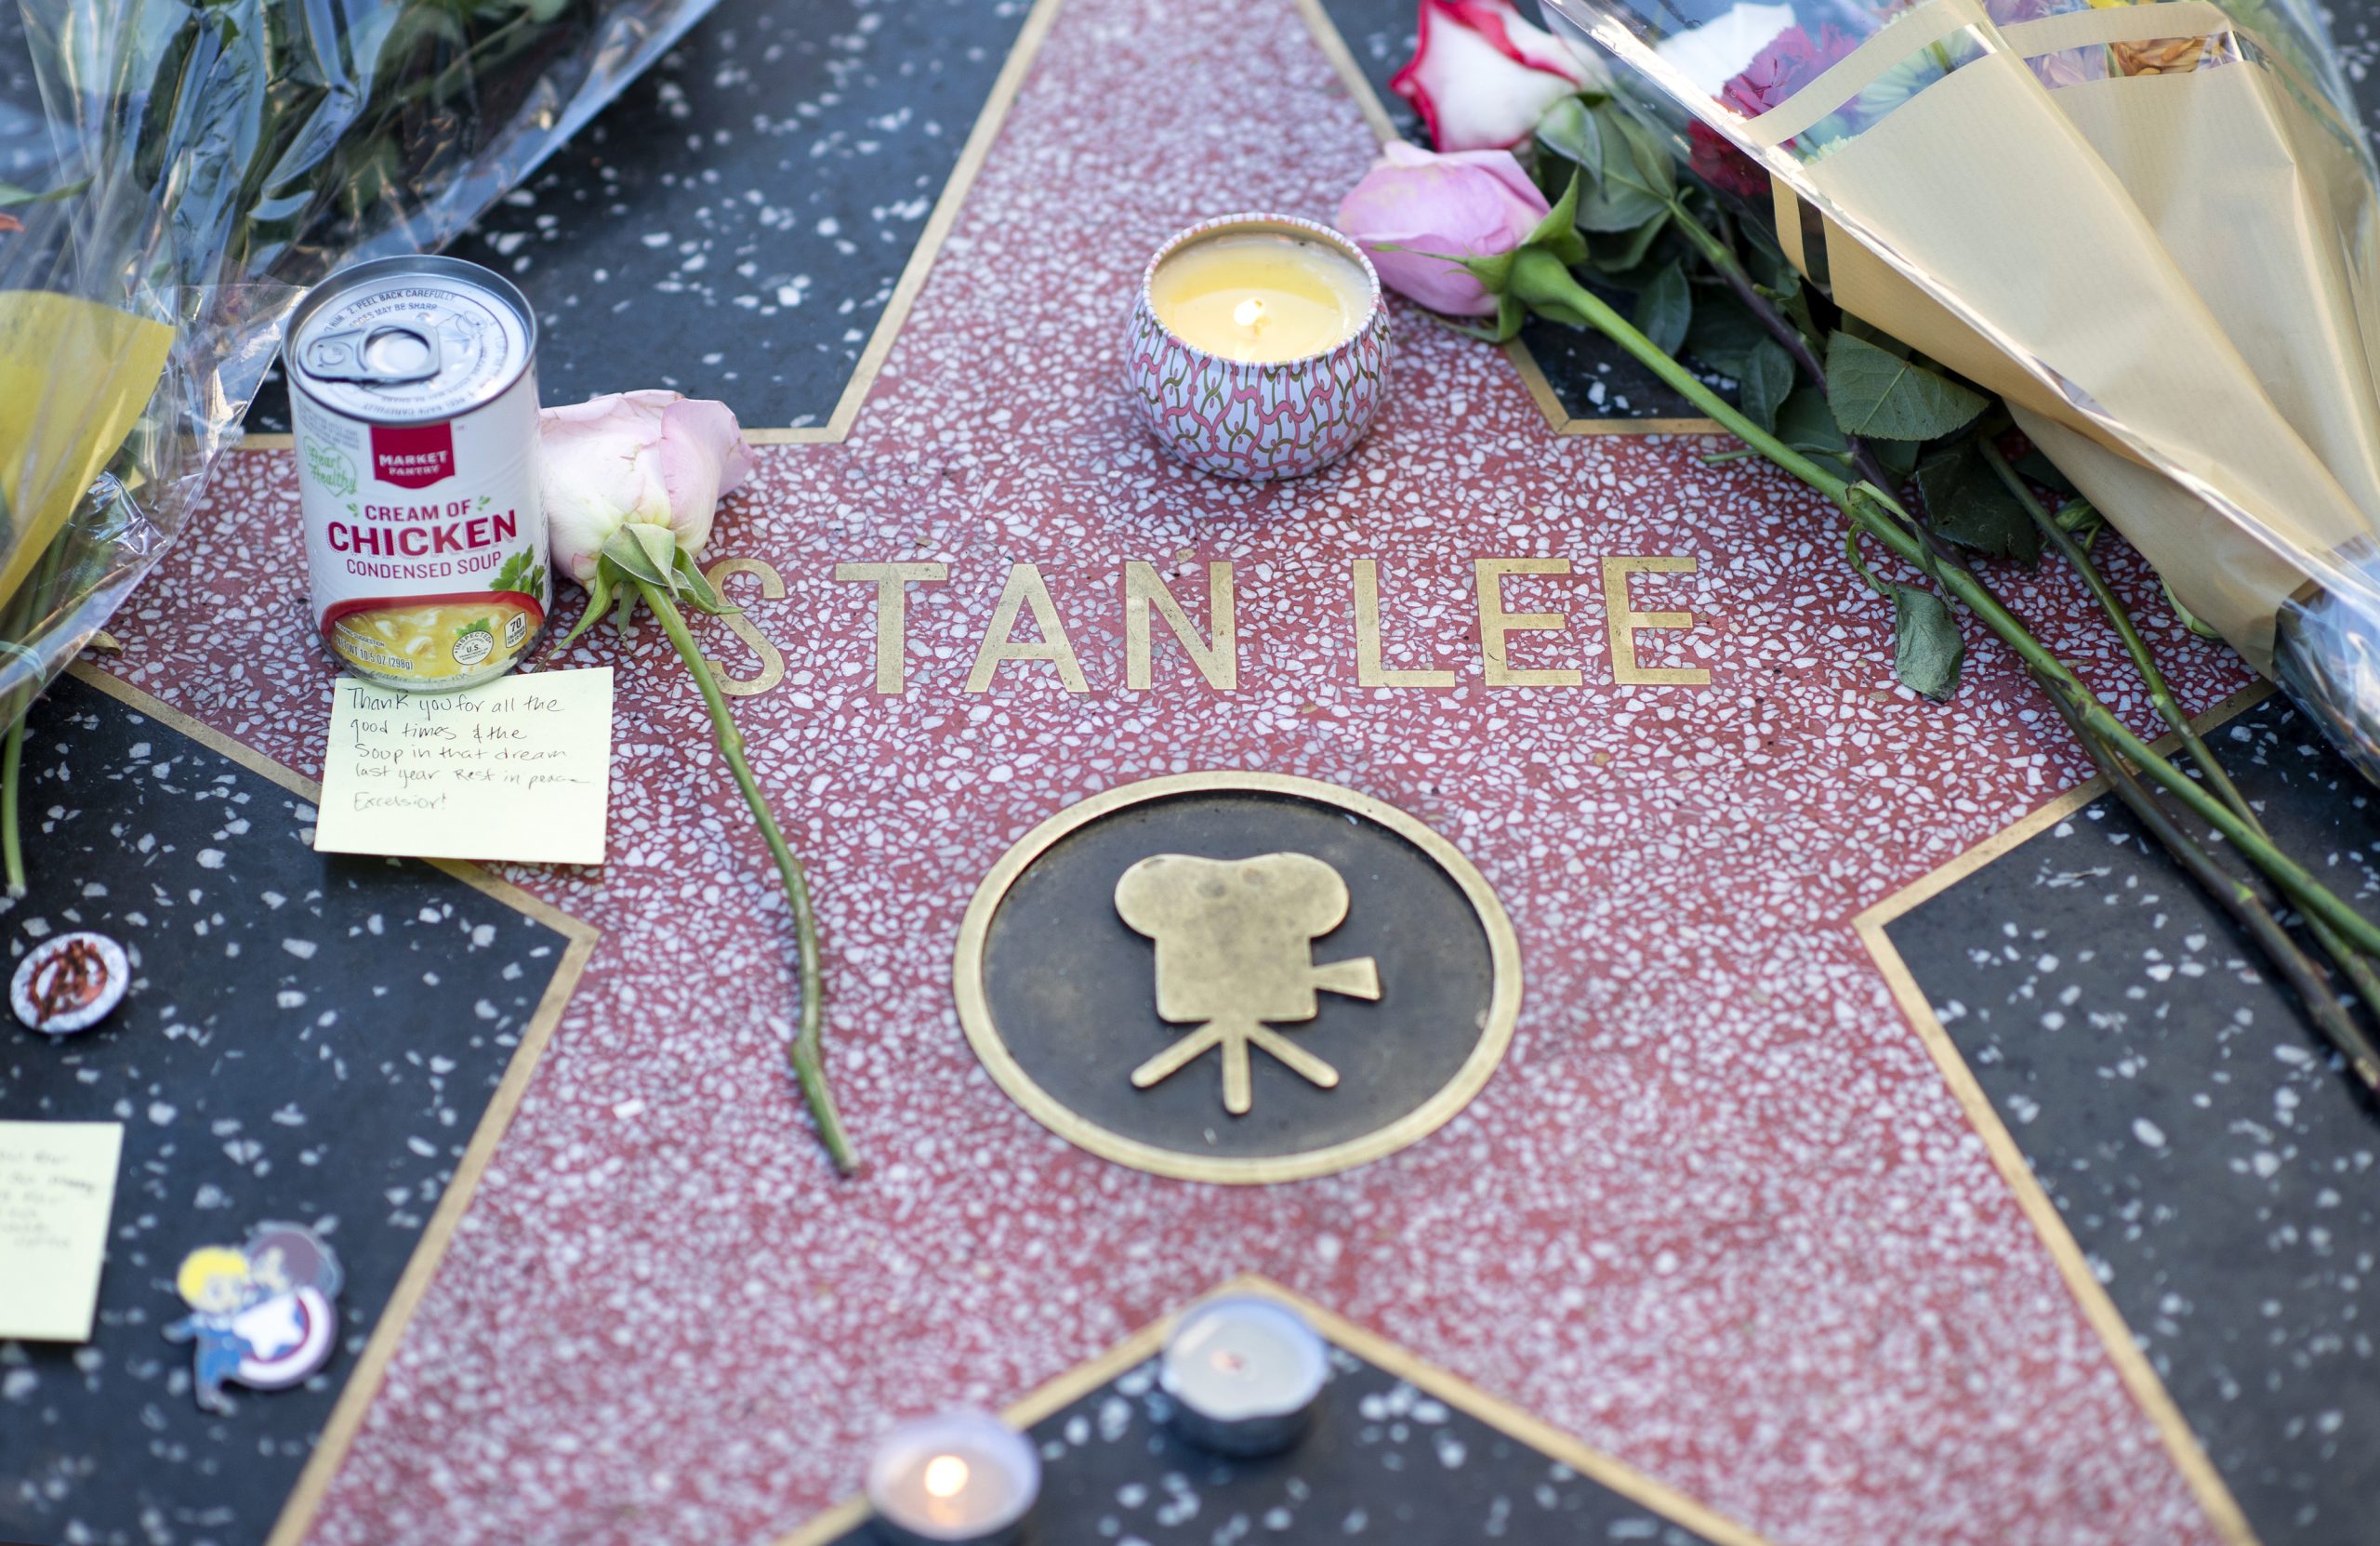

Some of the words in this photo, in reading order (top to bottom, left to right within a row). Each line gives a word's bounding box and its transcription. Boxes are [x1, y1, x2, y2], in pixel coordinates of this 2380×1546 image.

[357, 296, 379, 310] PEEL
[379, 290, 403, 302] BACK
[374, 306, 391, 316] MAY
[394, 302, 406, 311] BE
[307, 444, 342, 469] Heart
[378, 449, 448, 467] MARKET
[308, 462, 358, 495] Healthy
[388, 464, 440, 476] PANTRY
[364, 505, 439, 522] CREAM
[446, 498, 471, 518] OF
[327, 509, 517, 558] CHICKEN
[346, 558, 452, 580] CONDENSED
[456, 550, 502, 575] SOUP
[509, 617, 522, 633] 70
[705, 557, 1237, 696] STAN
[1351, 556, 1712, 688] LEE
[337, 634, 348, 650] NET
[349, 642, 358, 656] WT
[377, 654, 386, 666] OZ
[388, 656, 414, 670] (298g)
[456, 632, 491, 650] INSPECTED
[347, 687, 409, 710] Thank
[419, 698, 452, 721] you
[456, 694, 485, 712] for
[491, 697, 515, 712] all
[523, 695, 565, 712] the
[350, 719, 388, 743] good
[402, 723, 457, 740] times
[486, 725, 527, 740] the
[412, 745, 431, 759] in
[439, 747, 488, 760] that
[495, 747, 567, 760] dream
[355, 762, 391, 777] last
[398, 769, 441, 788] year
[454, 768, 496, 782] Rest
[503, 770, 521, 785] in
[353, 791, 446, 812] Excelsior!
